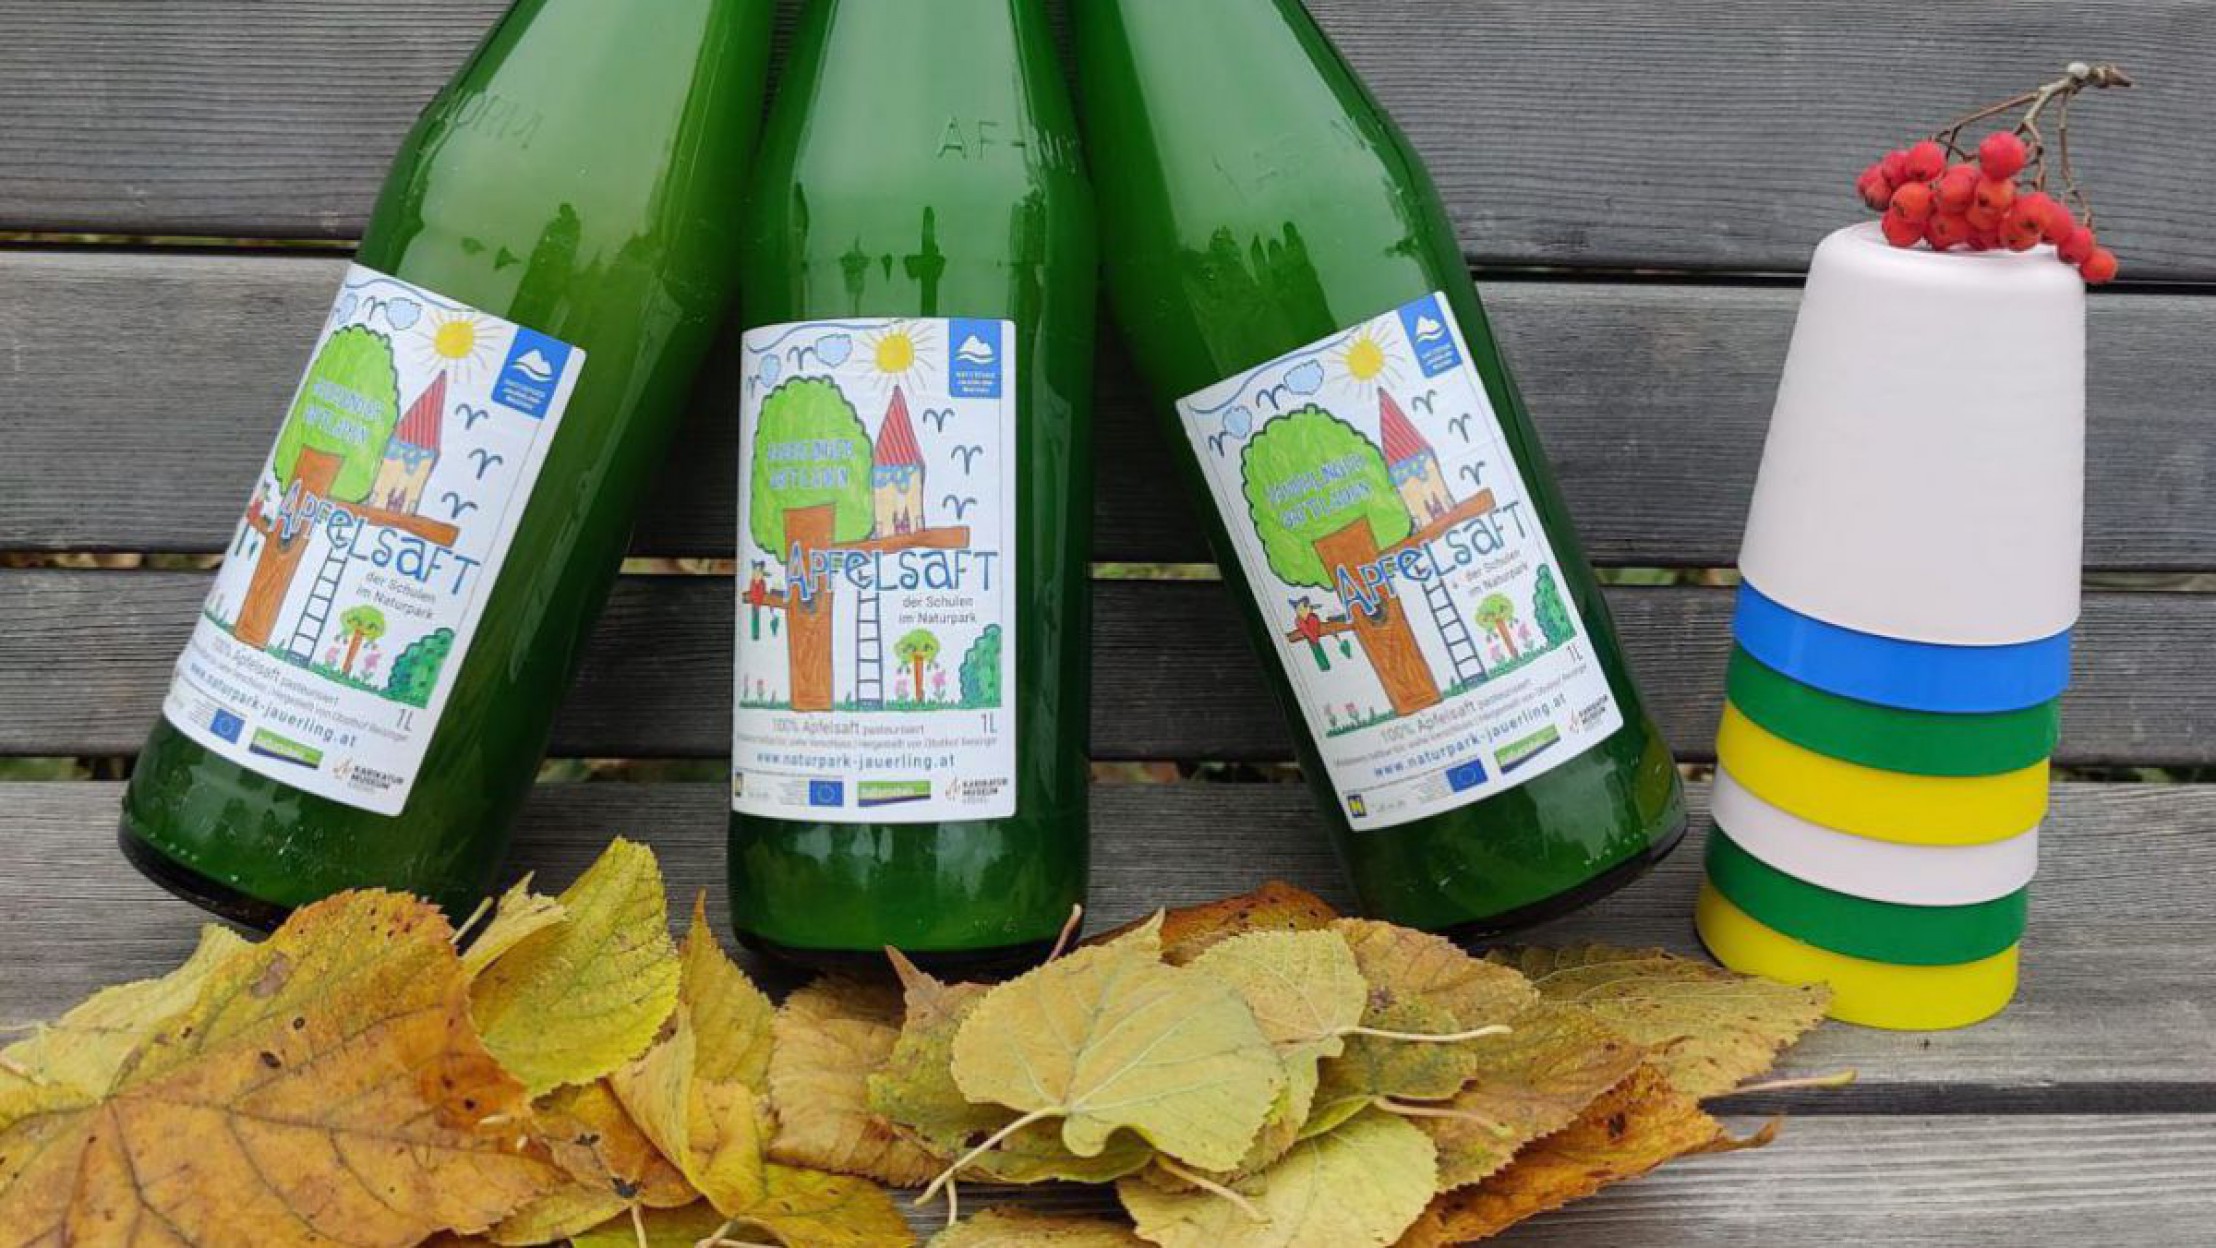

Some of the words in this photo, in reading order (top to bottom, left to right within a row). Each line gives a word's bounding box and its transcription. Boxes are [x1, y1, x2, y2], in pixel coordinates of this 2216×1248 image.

[373, 590, 433, 619] Naturpark
[902, 594, 922, 608] der
[926, 594, 975, 608] Schulen
[899, 613, 915, 624] im
[918, 612, 977, 626] Naturpark
[980, 711, 998, 734] 1L
[756, 751, 955, 771] www.naturpark-jauerling.at
